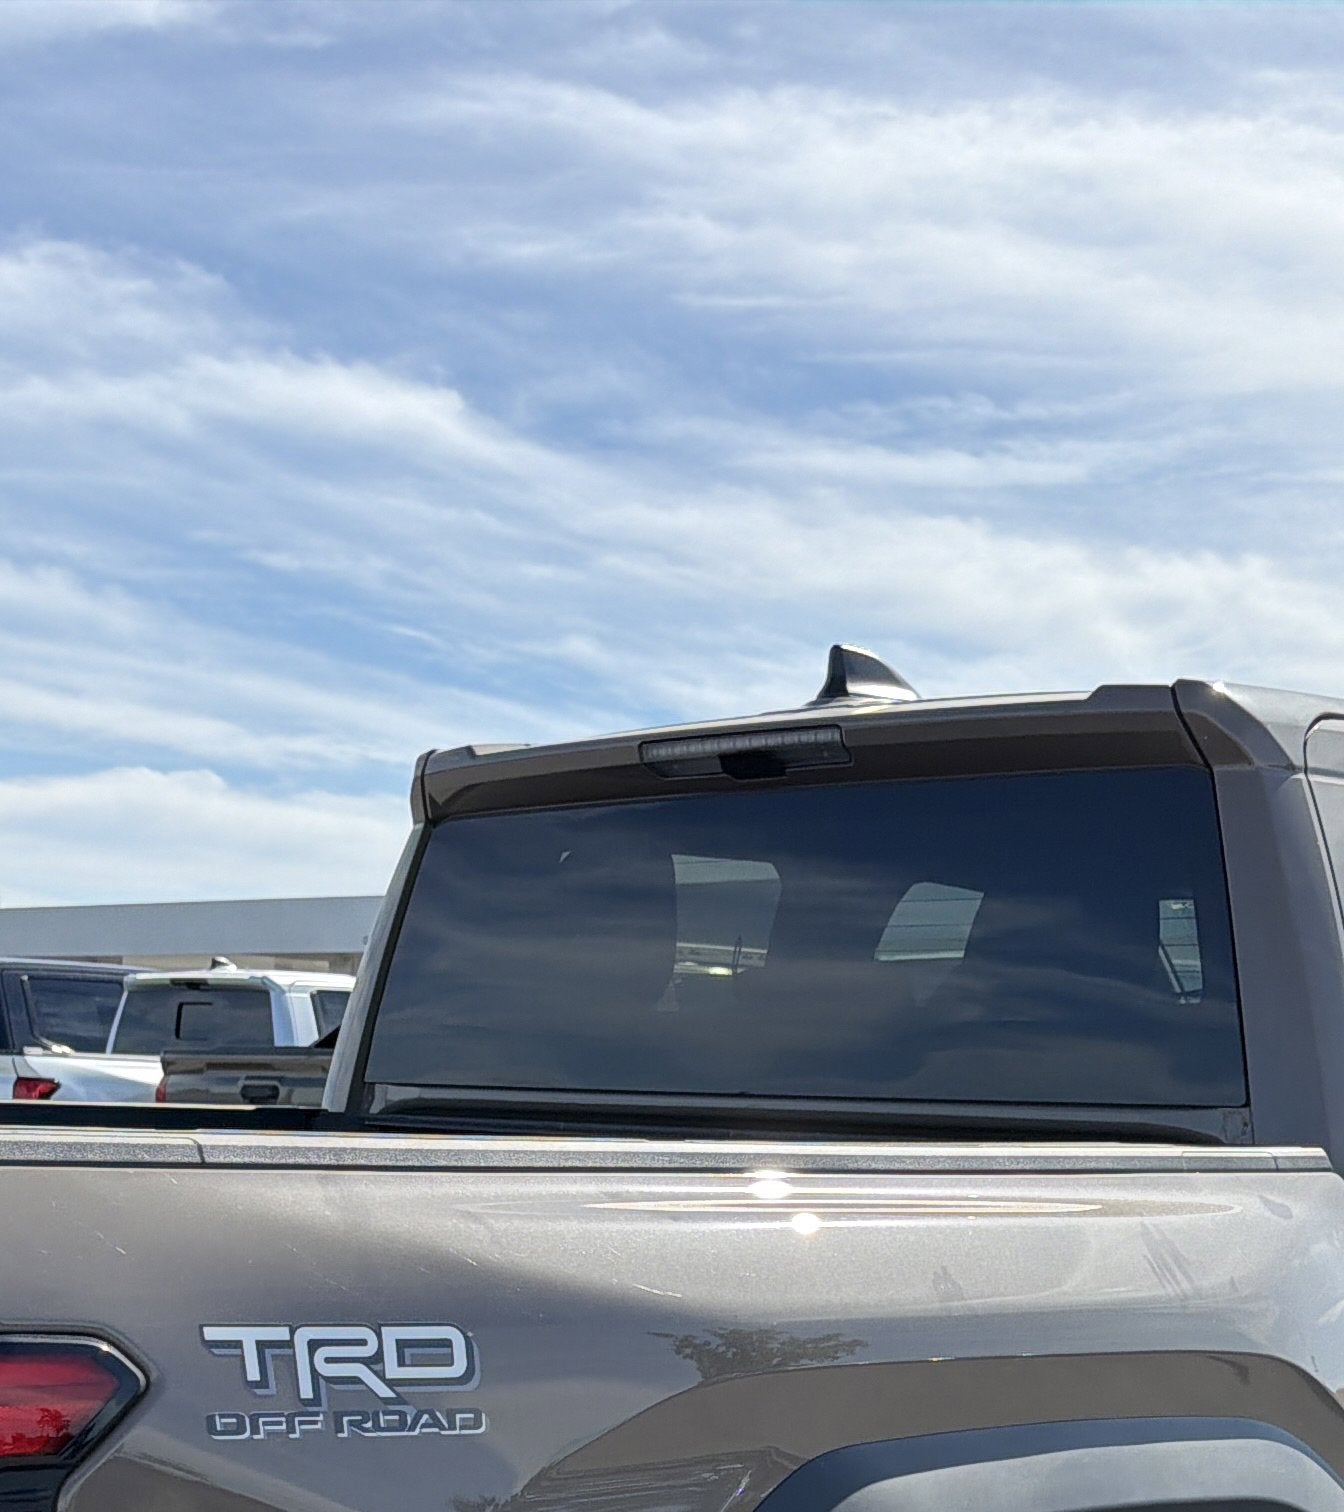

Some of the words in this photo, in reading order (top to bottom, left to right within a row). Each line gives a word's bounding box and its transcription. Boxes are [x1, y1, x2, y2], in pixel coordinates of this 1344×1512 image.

[199, 1323, 481, 1412] TRD
[206, 1411, 323, 1441] OFF
[333, 1406, 488, 1440] ROAD
